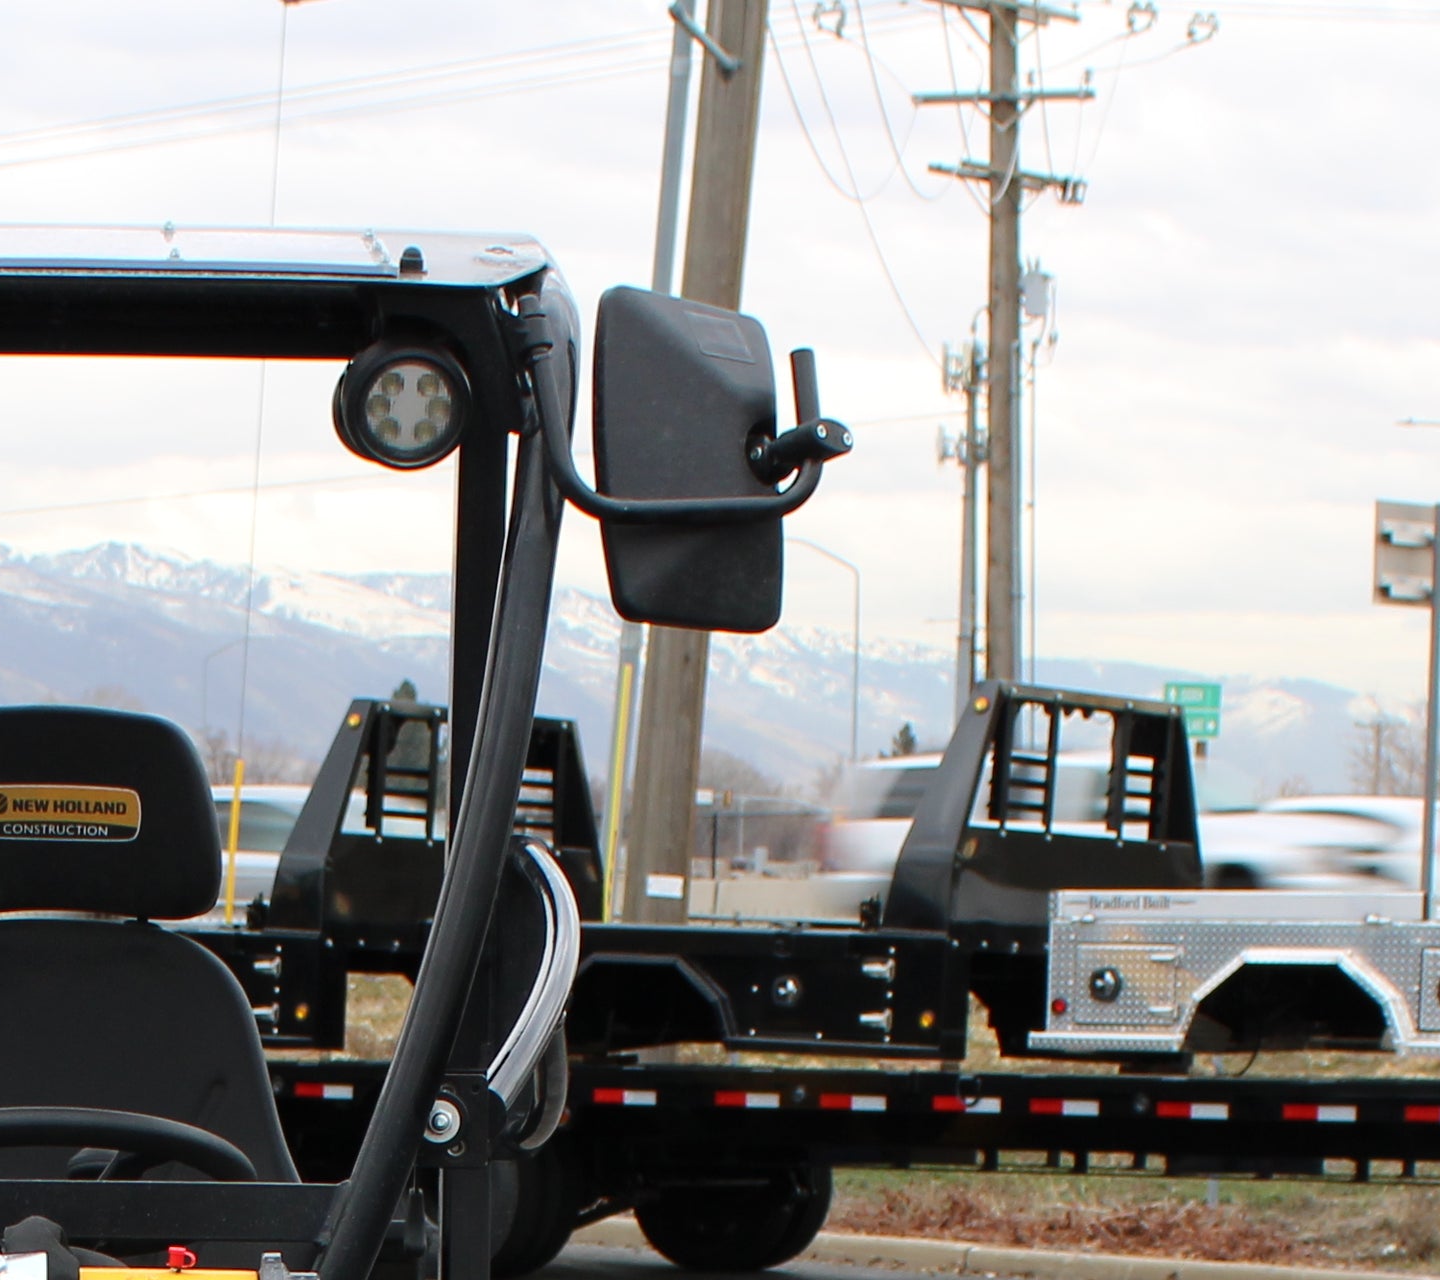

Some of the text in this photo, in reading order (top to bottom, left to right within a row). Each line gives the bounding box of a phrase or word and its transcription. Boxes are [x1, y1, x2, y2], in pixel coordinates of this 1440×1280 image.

[11, 799, 127, 815] NEW HOLLAND
[2, 823, 109, 836] CONSTRUCTION
[1088, 895, 1171, 910] Bradford Built
